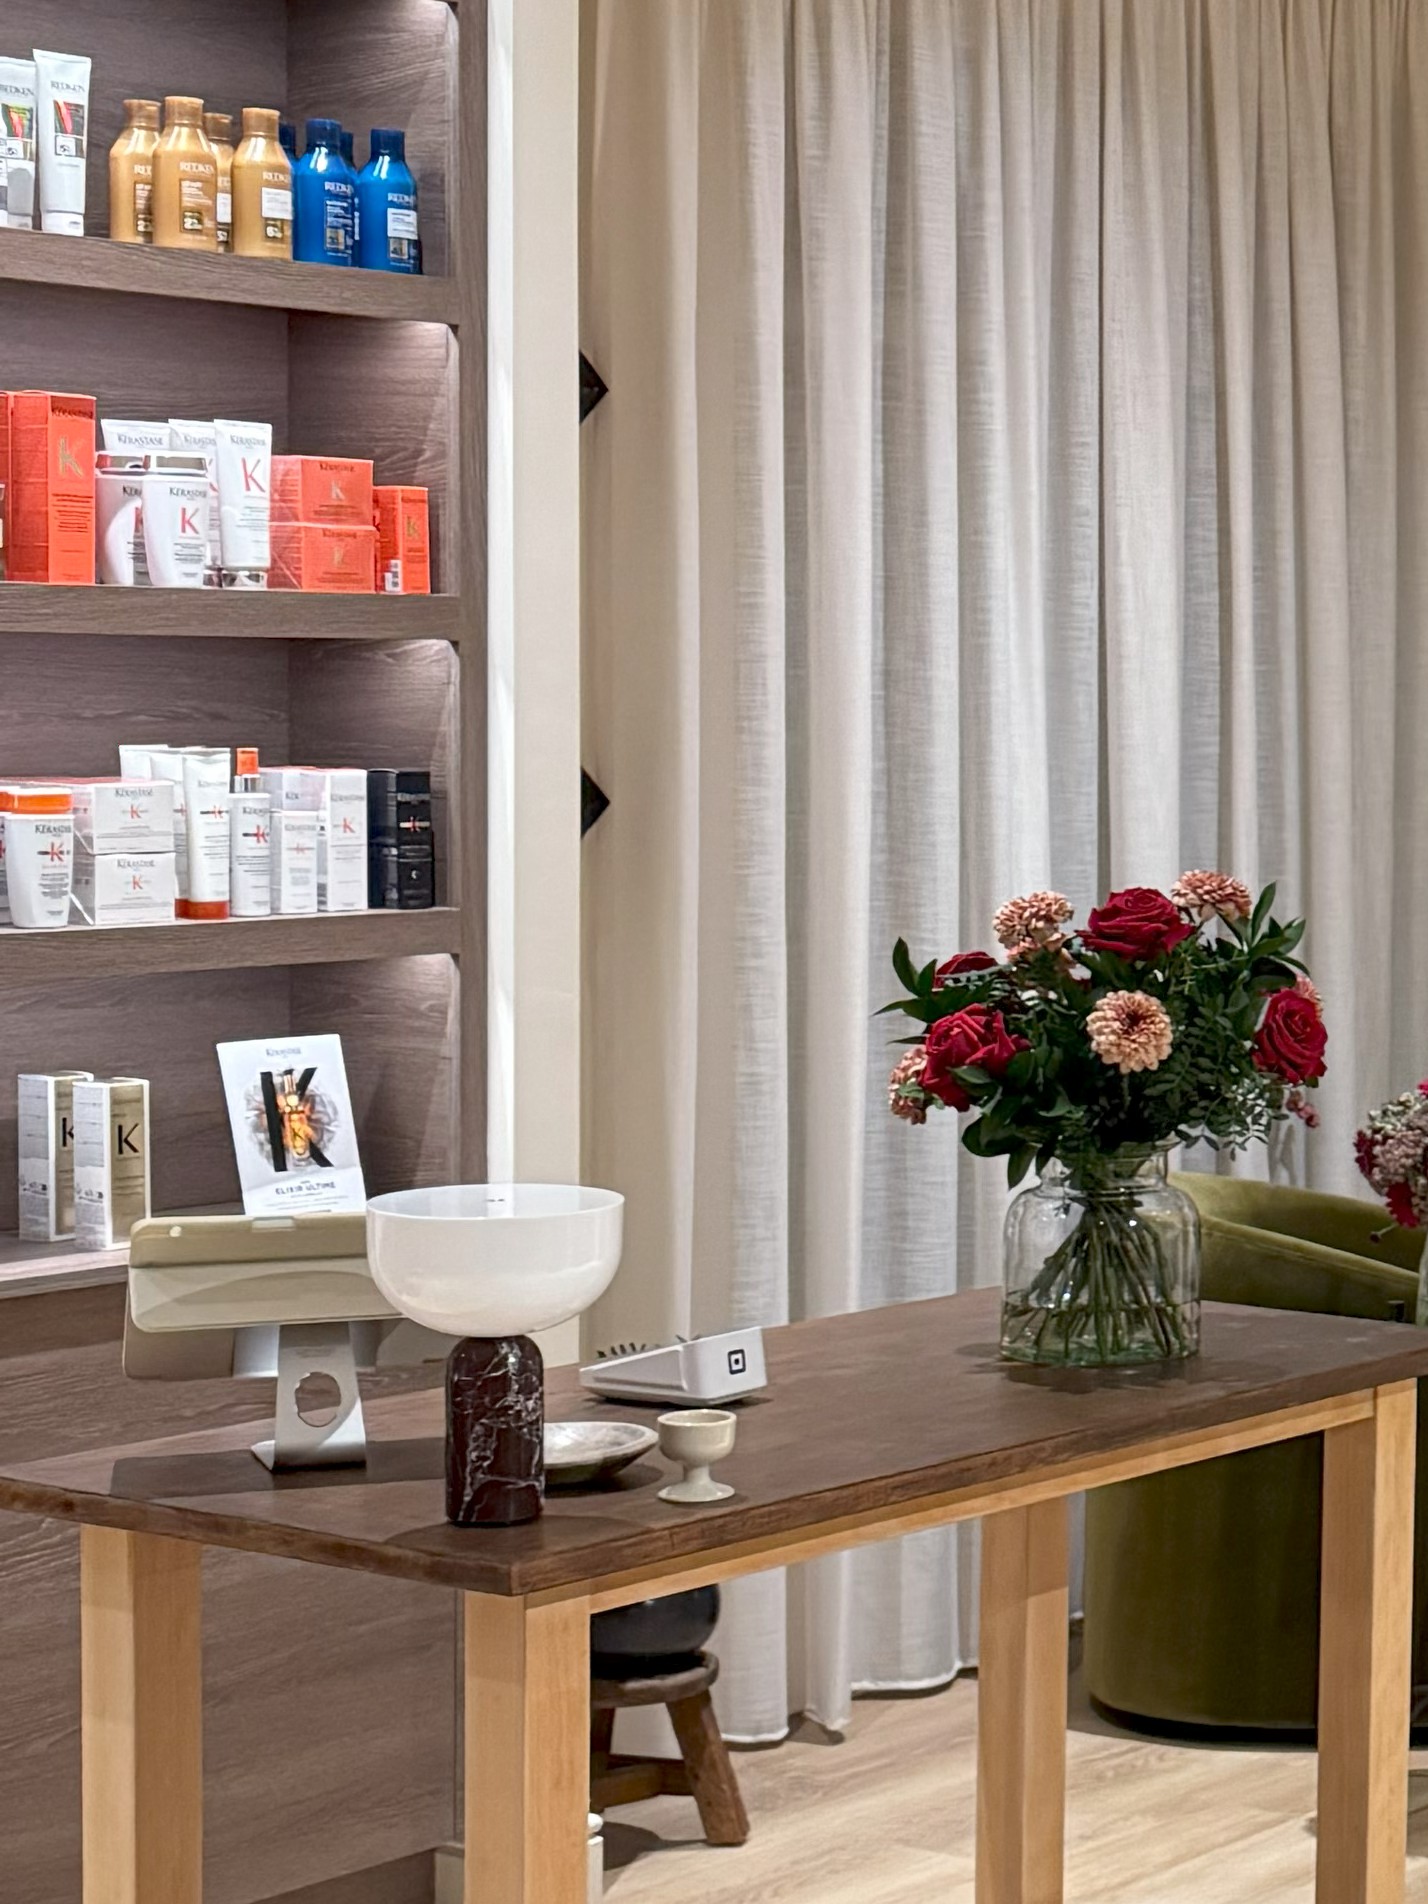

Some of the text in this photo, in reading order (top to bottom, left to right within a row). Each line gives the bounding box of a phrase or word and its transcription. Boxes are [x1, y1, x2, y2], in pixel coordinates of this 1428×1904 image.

[241, 457, 265, 493] K
[181, 507, 199, 534] K
[130, 804, 142, 819] K
[50, 842, 64, 863] K
[133, 875, 144, 890] K
[260, 1067, 334, 1173] K
[118, 1123, 139, 1154] K
